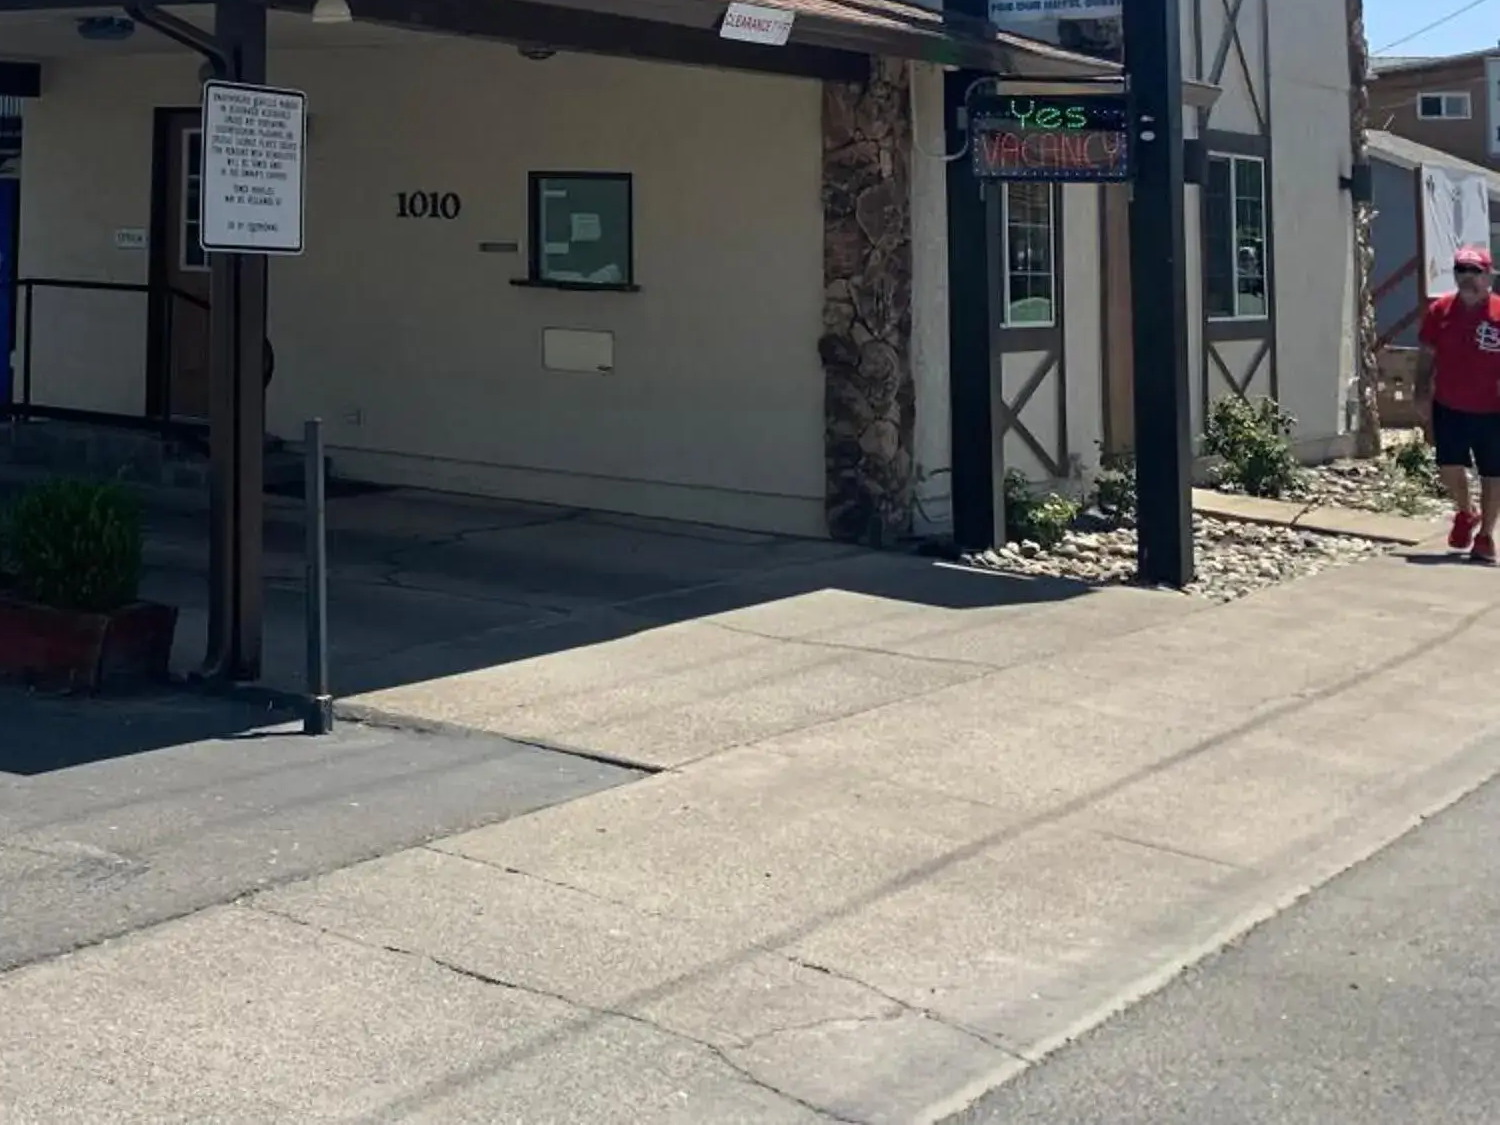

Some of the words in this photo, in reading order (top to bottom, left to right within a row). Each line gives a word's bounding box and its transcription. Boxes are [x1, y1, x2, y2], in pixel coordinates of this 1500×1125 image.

[1015, 0, 1041, 12] OUR
[1010, 99, 1088, 130] Yes
[981, 131, 1121, 169] VACANCY
[395, 190, 461, 219] 1010
